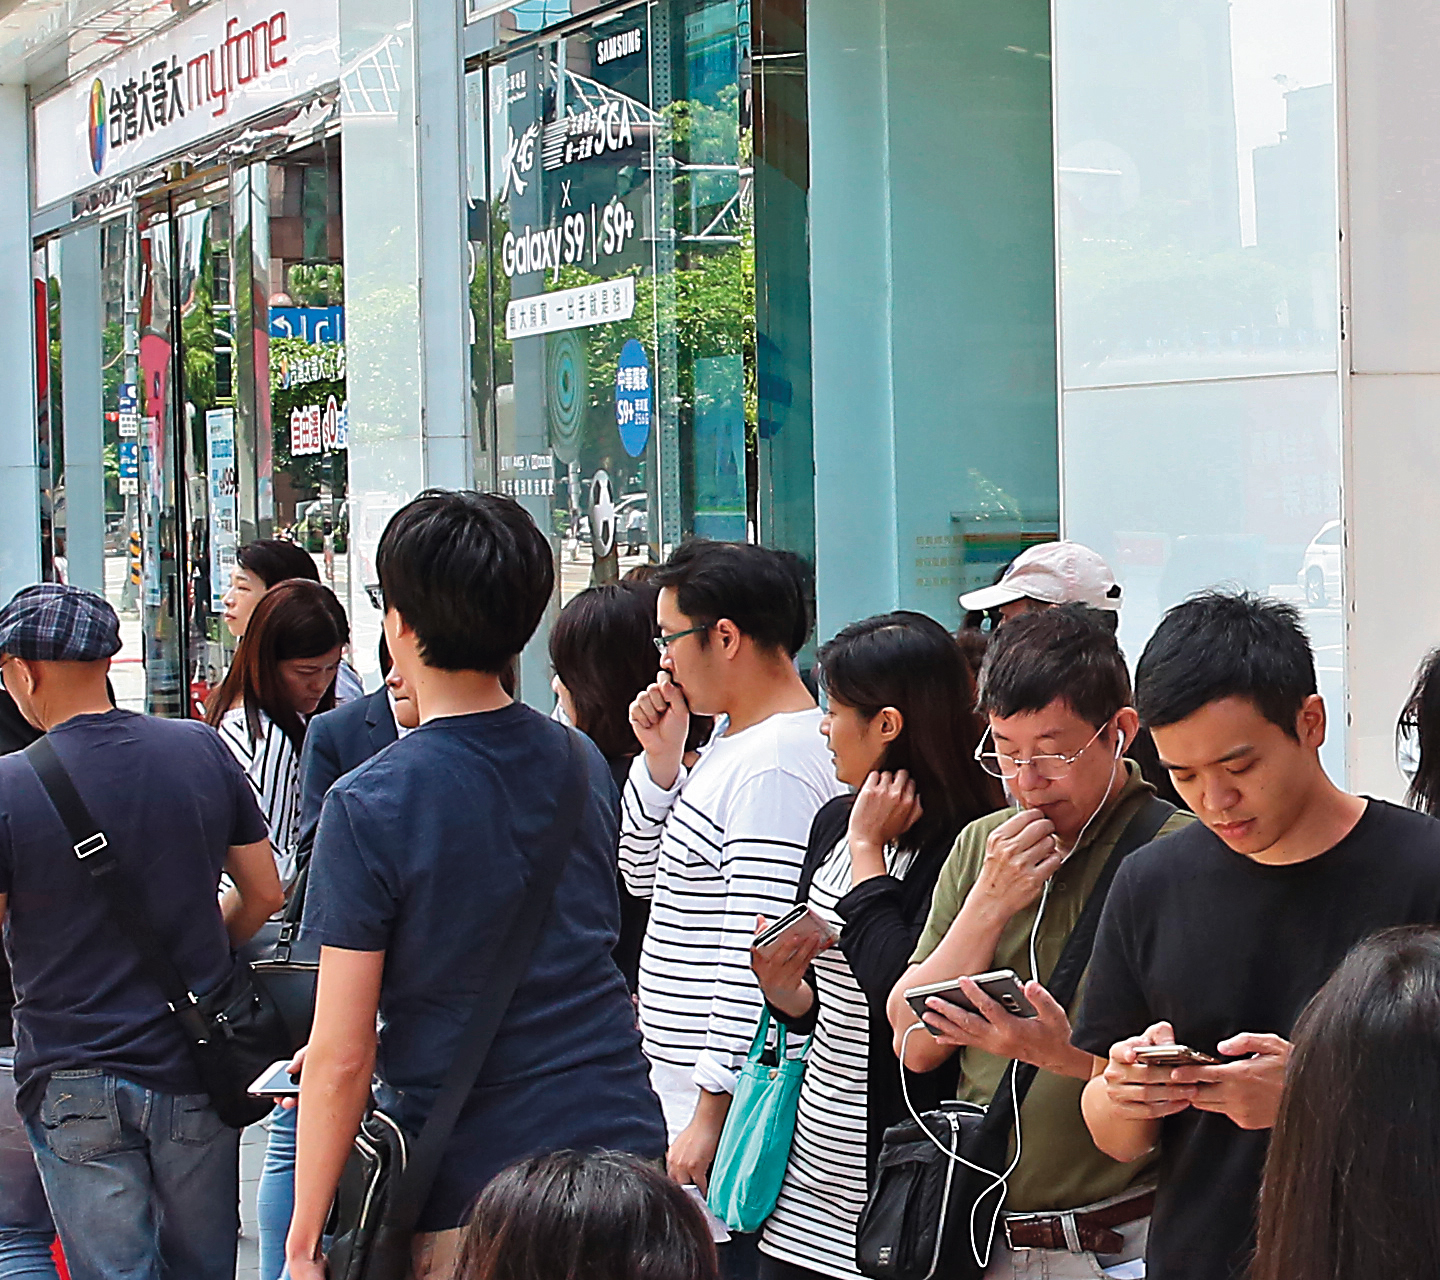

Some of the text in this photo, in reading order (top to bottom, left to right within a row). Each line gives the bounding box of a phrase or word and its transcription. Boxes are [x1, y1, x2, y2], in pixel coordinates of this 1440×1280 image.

[109, 11, 287, 149] 台灣大哥大 myfone
[596, 28, 642, 66] SAMSUNG
[502, 201, 636, 284] Galaxy S9 S9+
